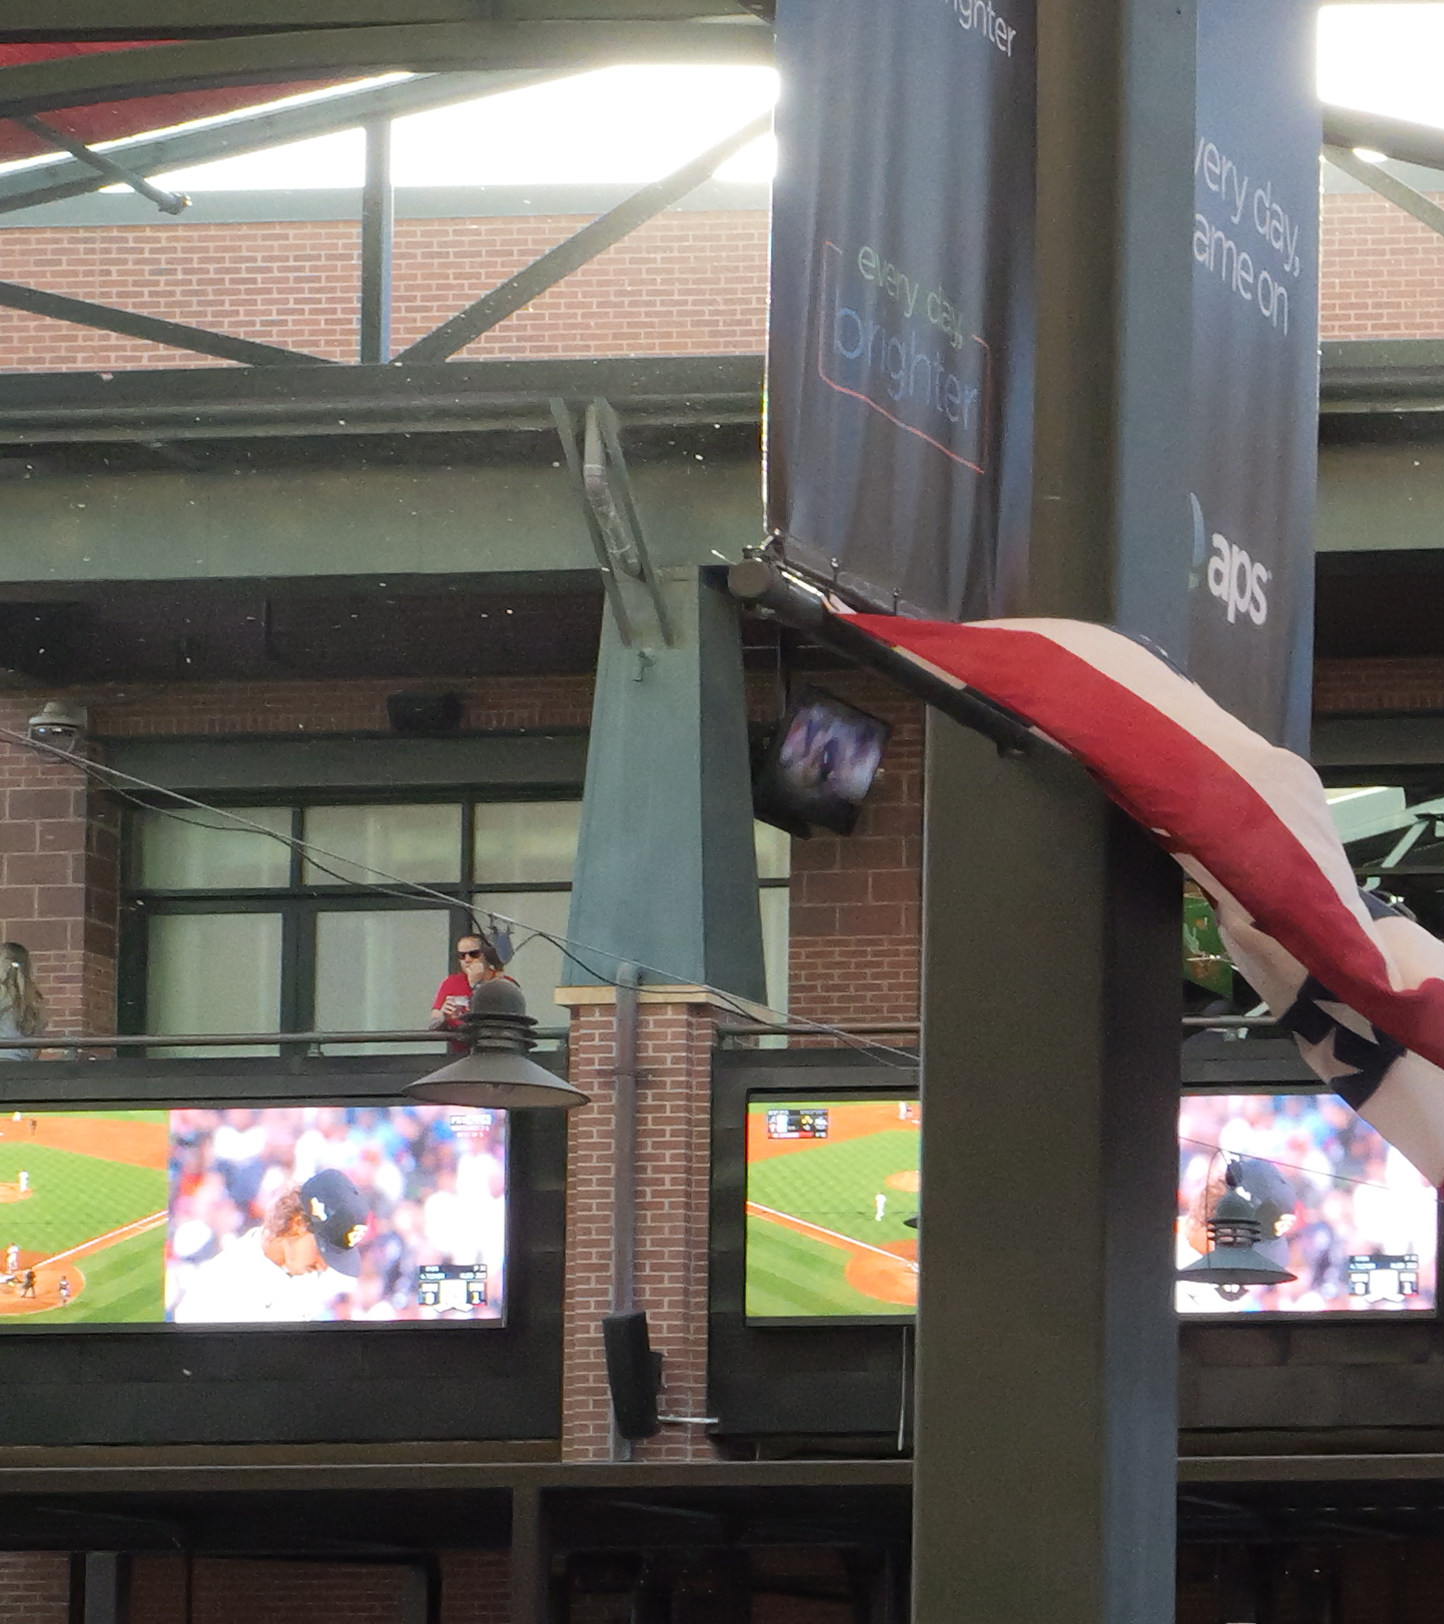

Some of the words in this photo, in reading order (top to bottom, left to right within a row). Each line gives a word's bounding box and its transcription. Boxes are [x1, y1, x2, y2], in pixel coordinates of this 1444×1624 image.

[1253, 180, 1299, 277] day,
[858, 246, 919, 319] every
[927, 282, 963, 350] day,
[1258, 270, 1288, 337] on
[834, 287, 977, 430] brighter
[1208, 533, 1267, 625] aps
